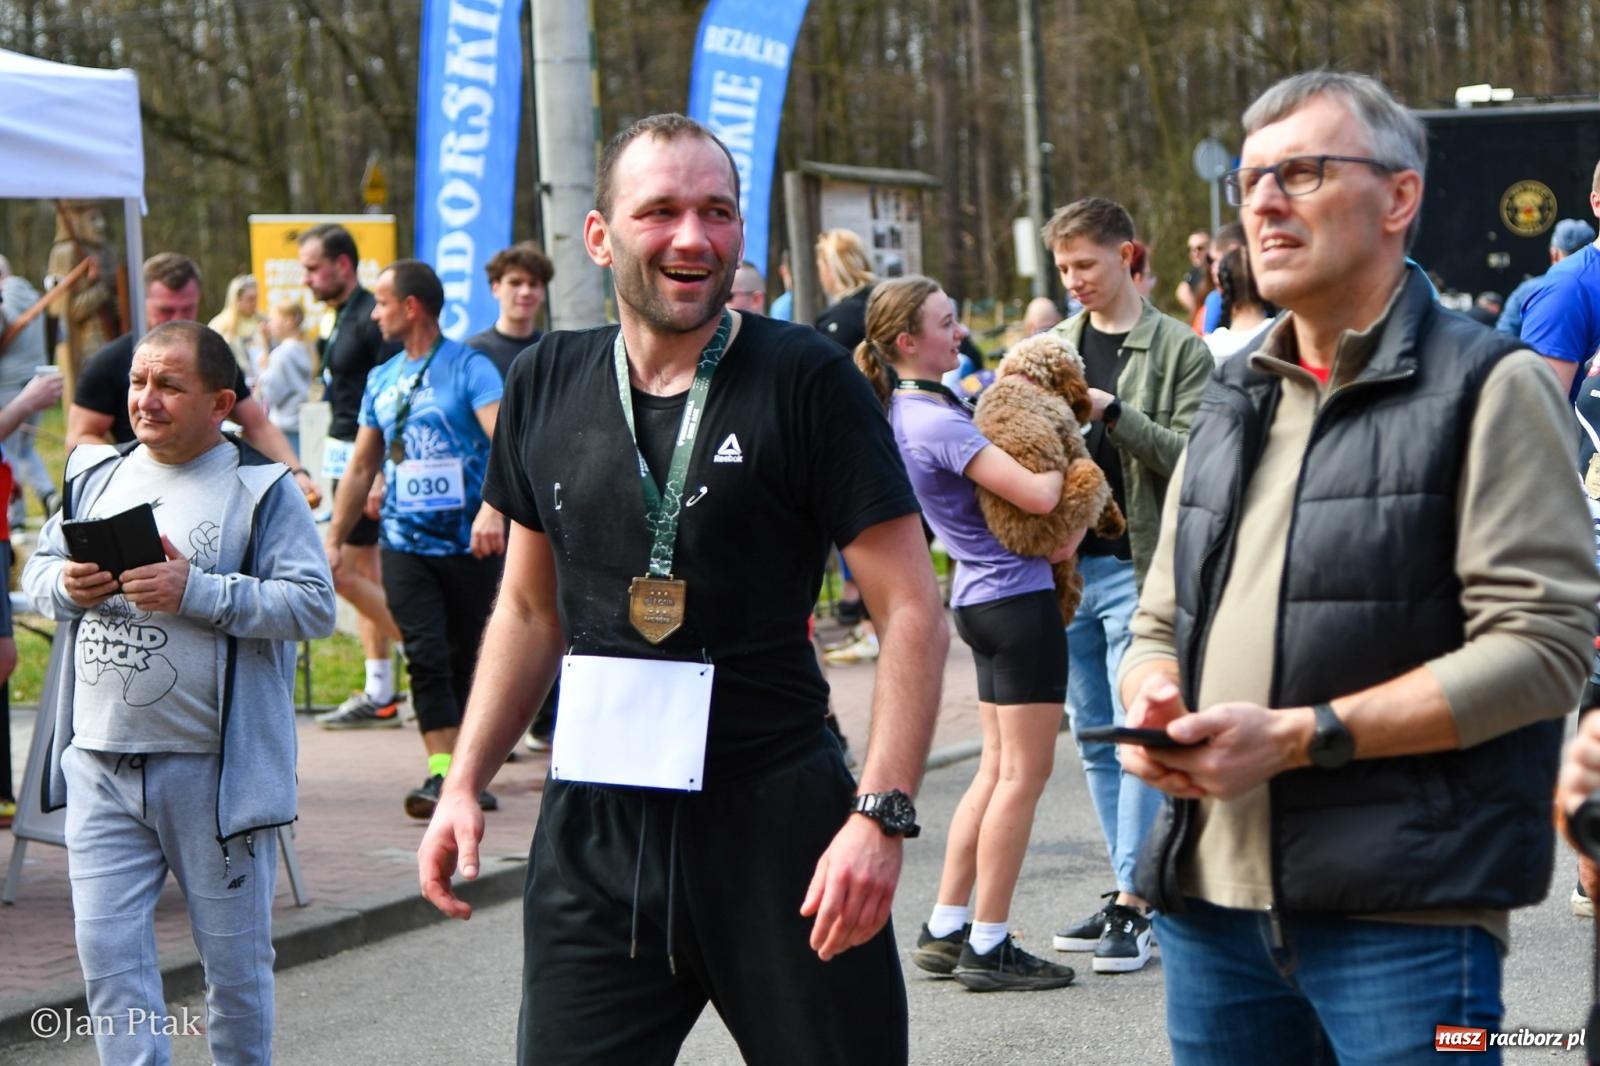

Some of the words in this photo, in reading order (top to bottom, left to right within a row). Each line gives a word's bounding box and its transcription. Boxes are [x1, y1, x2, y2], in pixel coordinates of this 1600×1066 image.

[712, 453, 744, 464] Reebok
[407, 476, 450, 496] 030
[83, 640, 151, 672] DUCK
